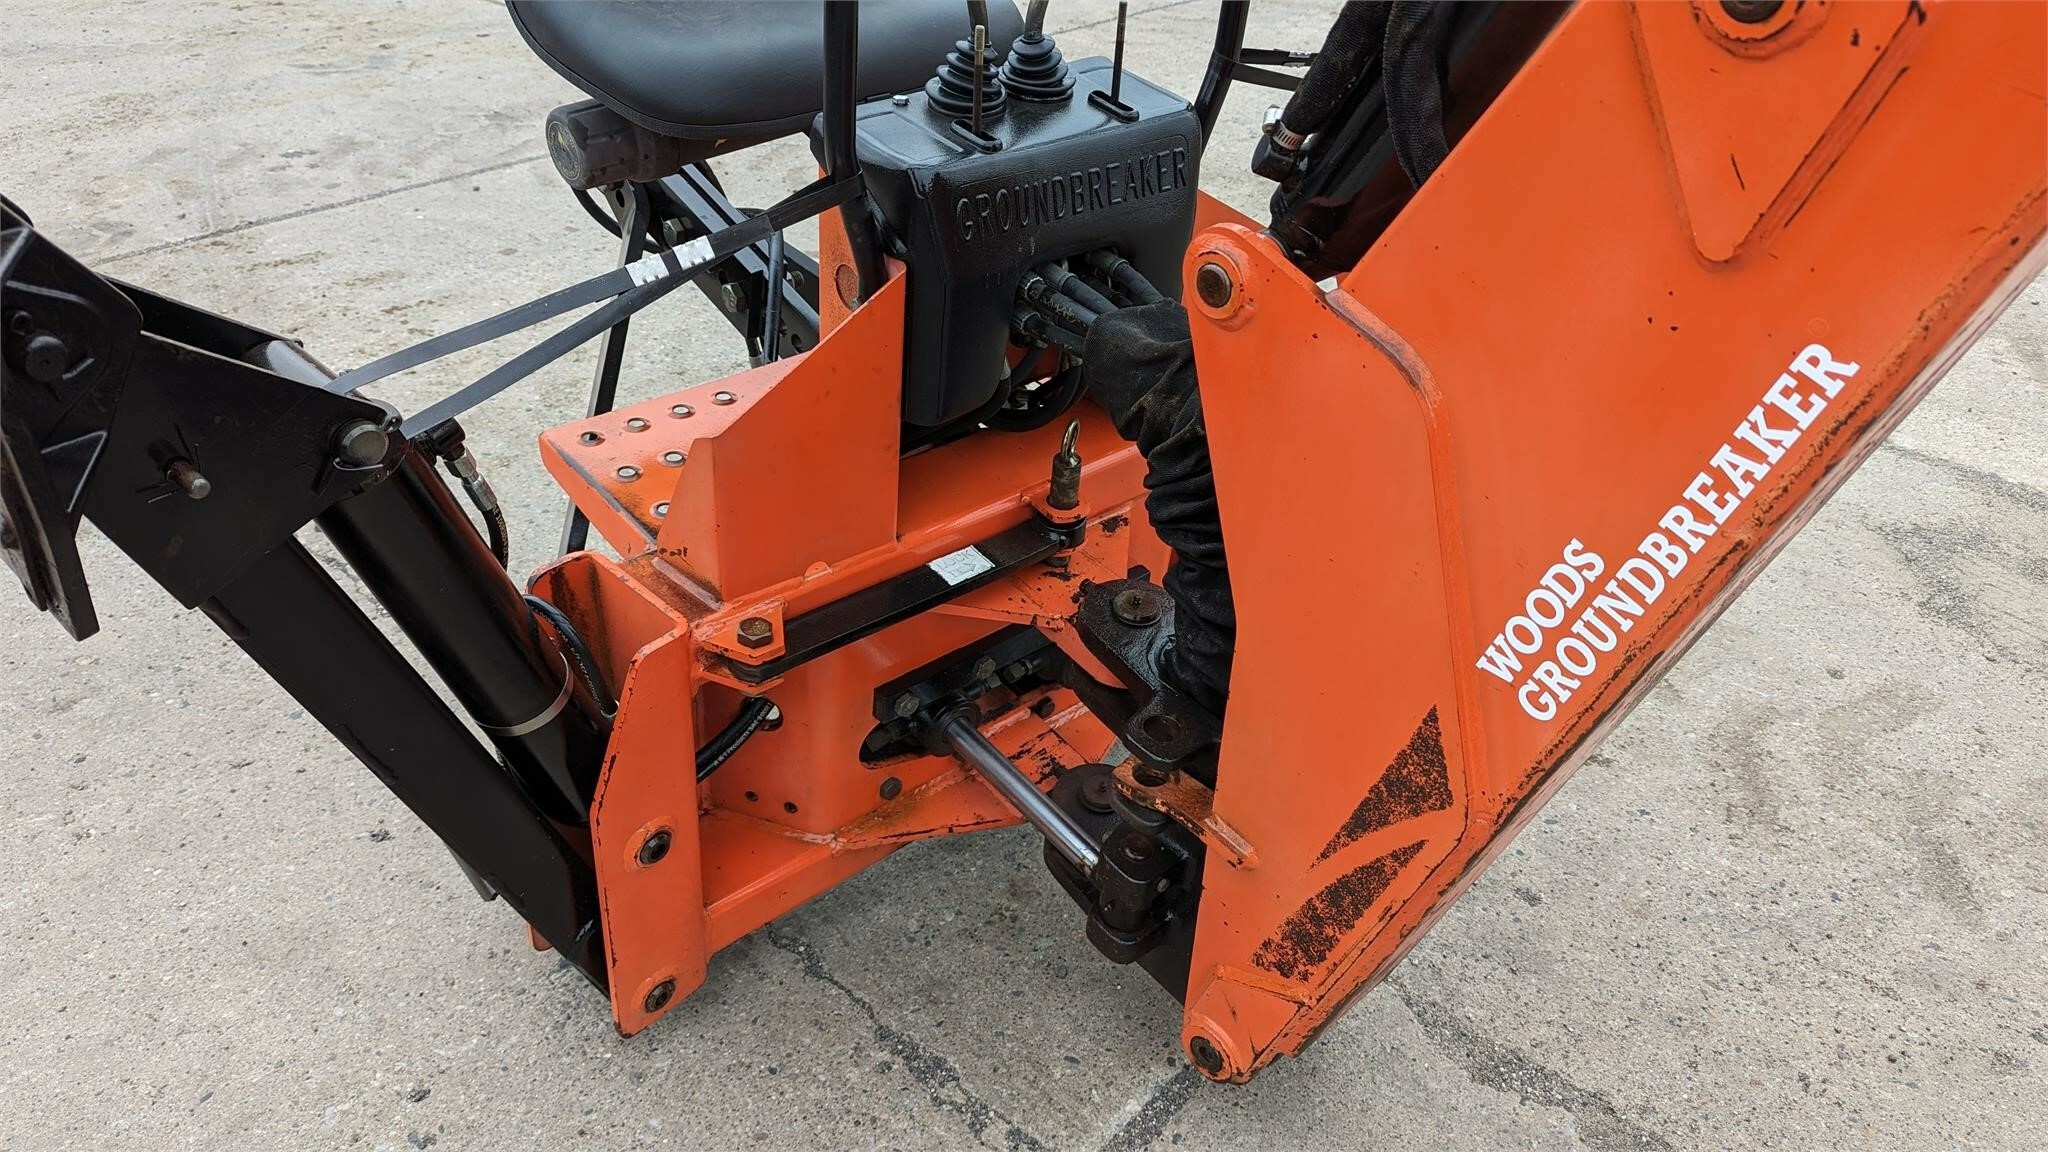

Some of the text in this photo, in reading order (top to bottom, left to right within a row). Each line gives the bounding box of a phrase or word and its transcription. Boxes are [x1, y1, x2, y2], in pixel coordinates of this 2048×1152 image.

[957, 147, 1187, 241] GROUNDBREAKER
[1517, 342, 1861, 722] GROUNDBREAKER
[1475, 537, 1606, 686] WOODS
